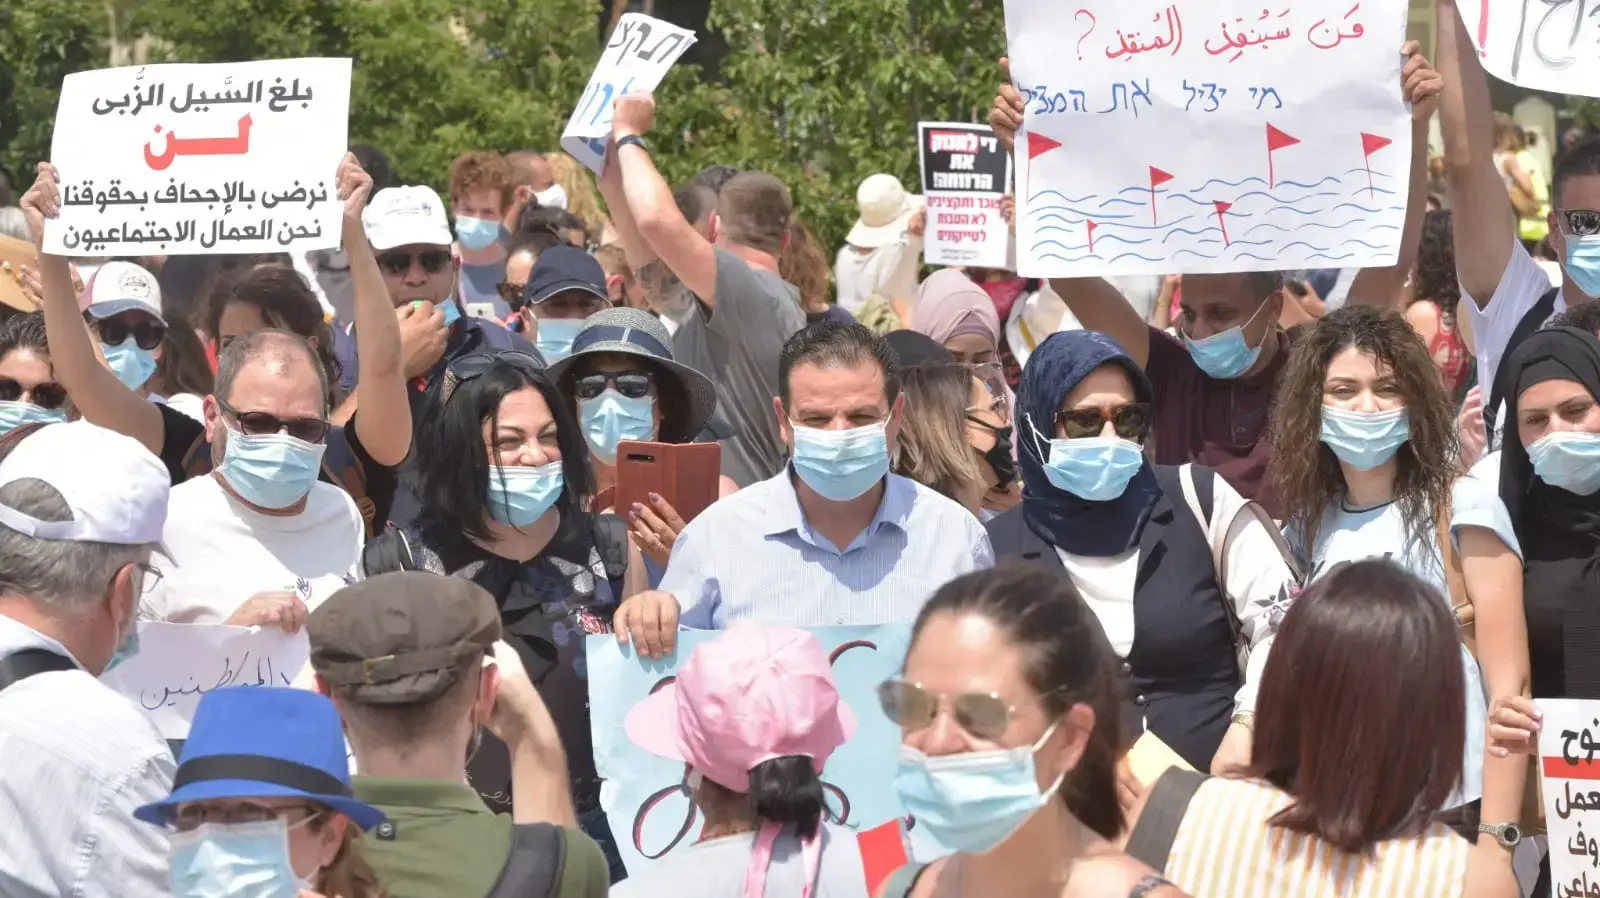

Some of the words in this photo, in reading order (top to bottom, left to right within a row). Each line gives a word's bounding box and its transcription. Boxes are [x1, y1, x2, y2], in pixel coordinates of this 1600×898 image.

[268, 76, 313, 112] بلغ
[1096, 77, 1153, 119] את
[1248, 86, 1283, 110] מי
[143, 112, 253, 171] لن
[949, 153, 975, 170] את
[64, 179, 149, 213] بحقوقنا
[153, 177, 256, 216] بالإجحاف
[261, 180, 328, 210] نرضى
[199, 218, 273, 248] العمال
[276, 218, 322, 245] نحن
[971, 212, 987, 225] לא
[63, 219, 195, 251] الاجتماعيون
